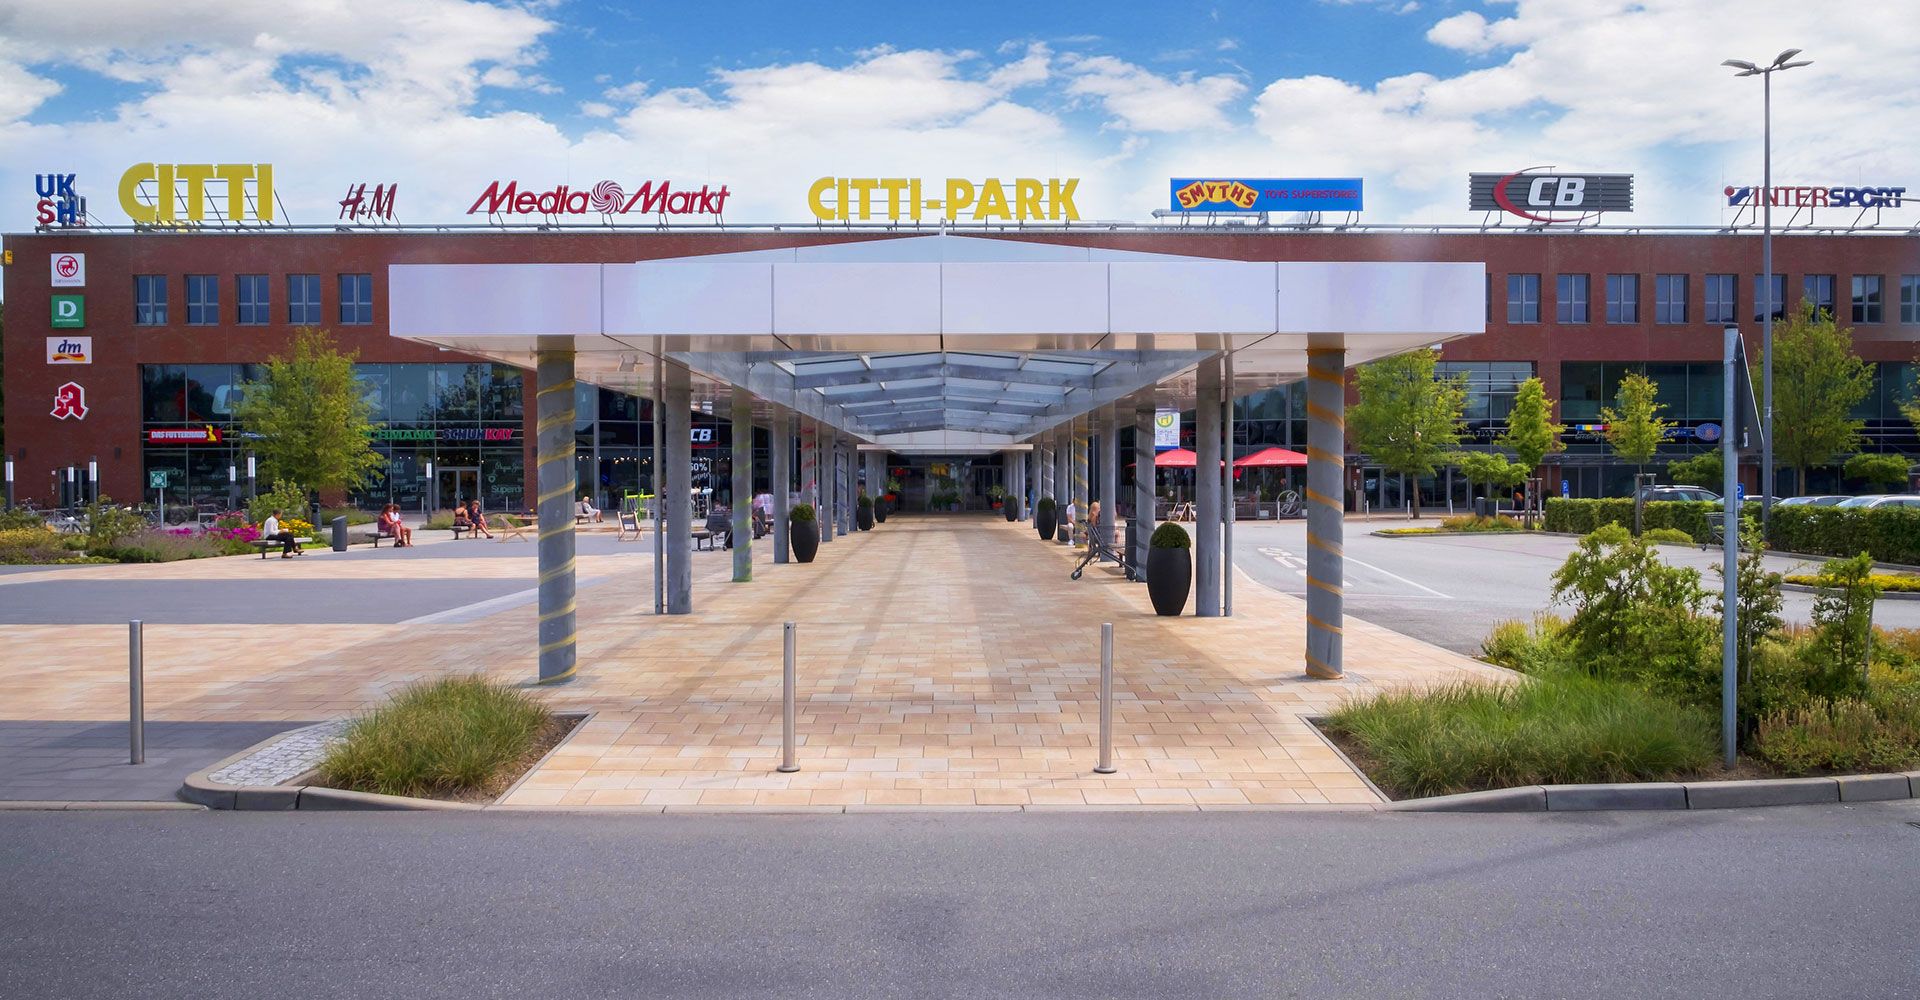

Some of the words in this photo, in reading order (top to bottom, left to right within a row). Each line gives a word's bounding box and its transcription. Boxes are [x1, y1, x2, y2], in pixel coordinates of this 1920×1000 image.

[35, 174, 76, 197] UK
[118, 162, 273, 222] CITTI
[466, 180, 590, 215] Media
[619, 180, 731, 215] Markt
[1178, 183, 1257, 207] SMYTHS
[1264, 189, 1288, 199] TOYS
[1291, 189, 1358, 199] SUPERSTORES
[1527, 177, 1586, 206] CB
[1754, 186, 1906, 208] INTERSPORT
[339, 183, 397, 221] H&M
[808, 176, 1081, 221] CITTI-PARK
[37, 199, 76, 224] SH
[58, 300, 77, 317] D
[58, 340, 82, 354] dm
[690, 428, 712, 441] CB
